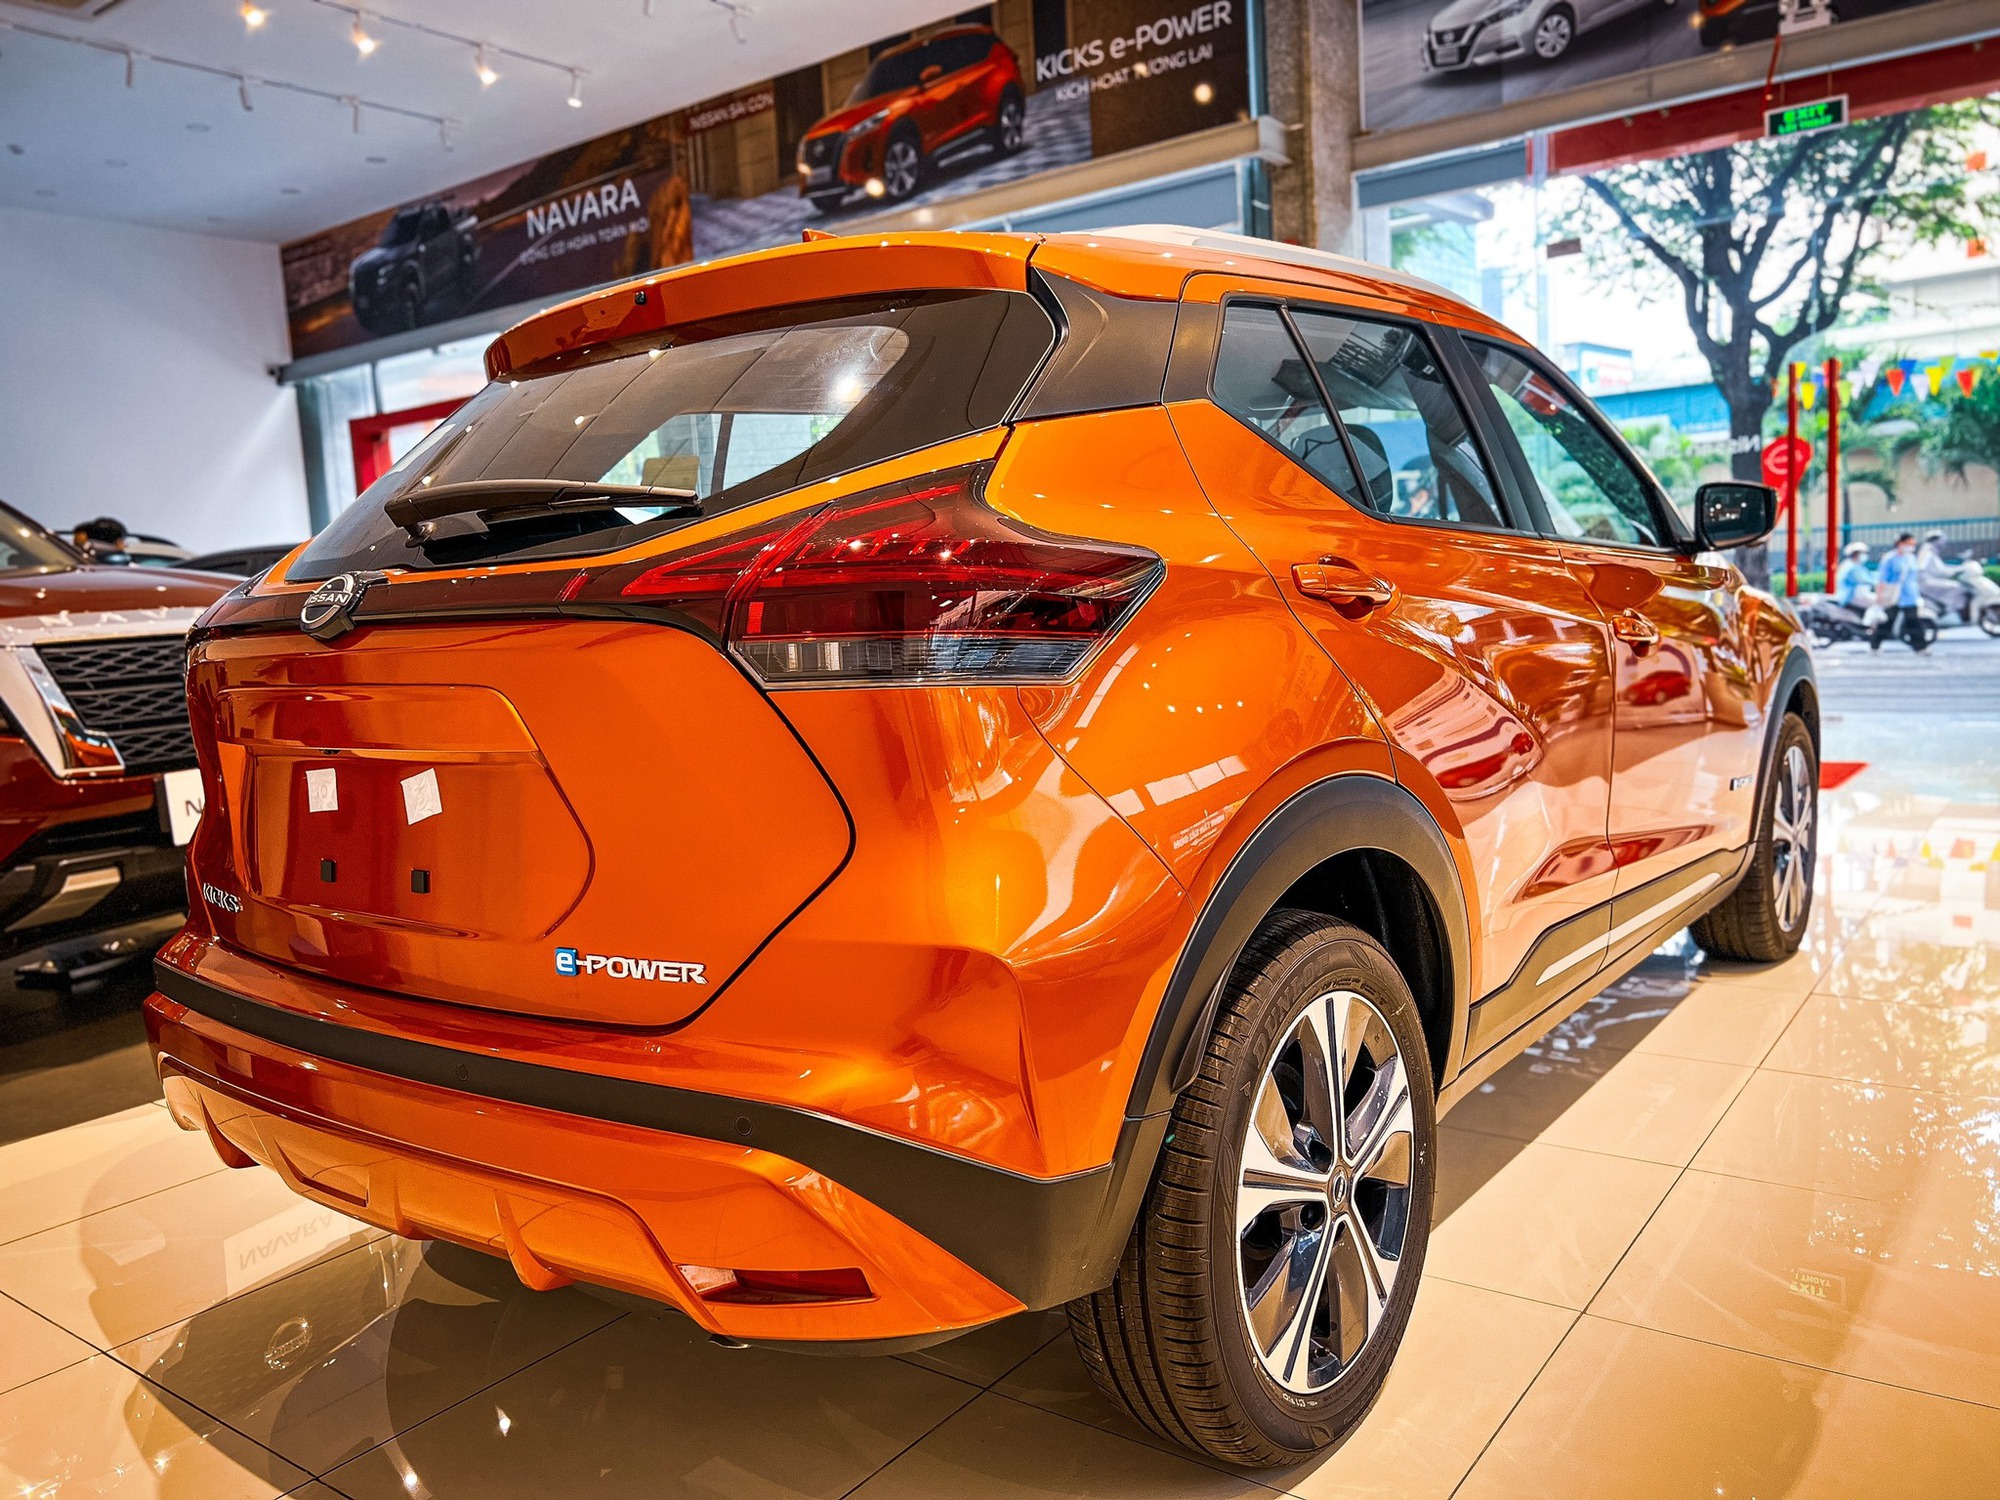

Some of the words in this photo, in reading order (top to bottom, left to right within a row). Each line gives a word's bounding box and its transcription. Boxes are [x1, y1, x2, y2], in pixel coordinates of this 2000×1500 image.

[1036, 39, 1105, 82] KICKS
[1109, 0, 1233, 59] e-POWER
[526, 178, 641, 239] NAVARA
[203, 882, 239, 913] KICKS
[555, 949, 708, 985] e-POWER
